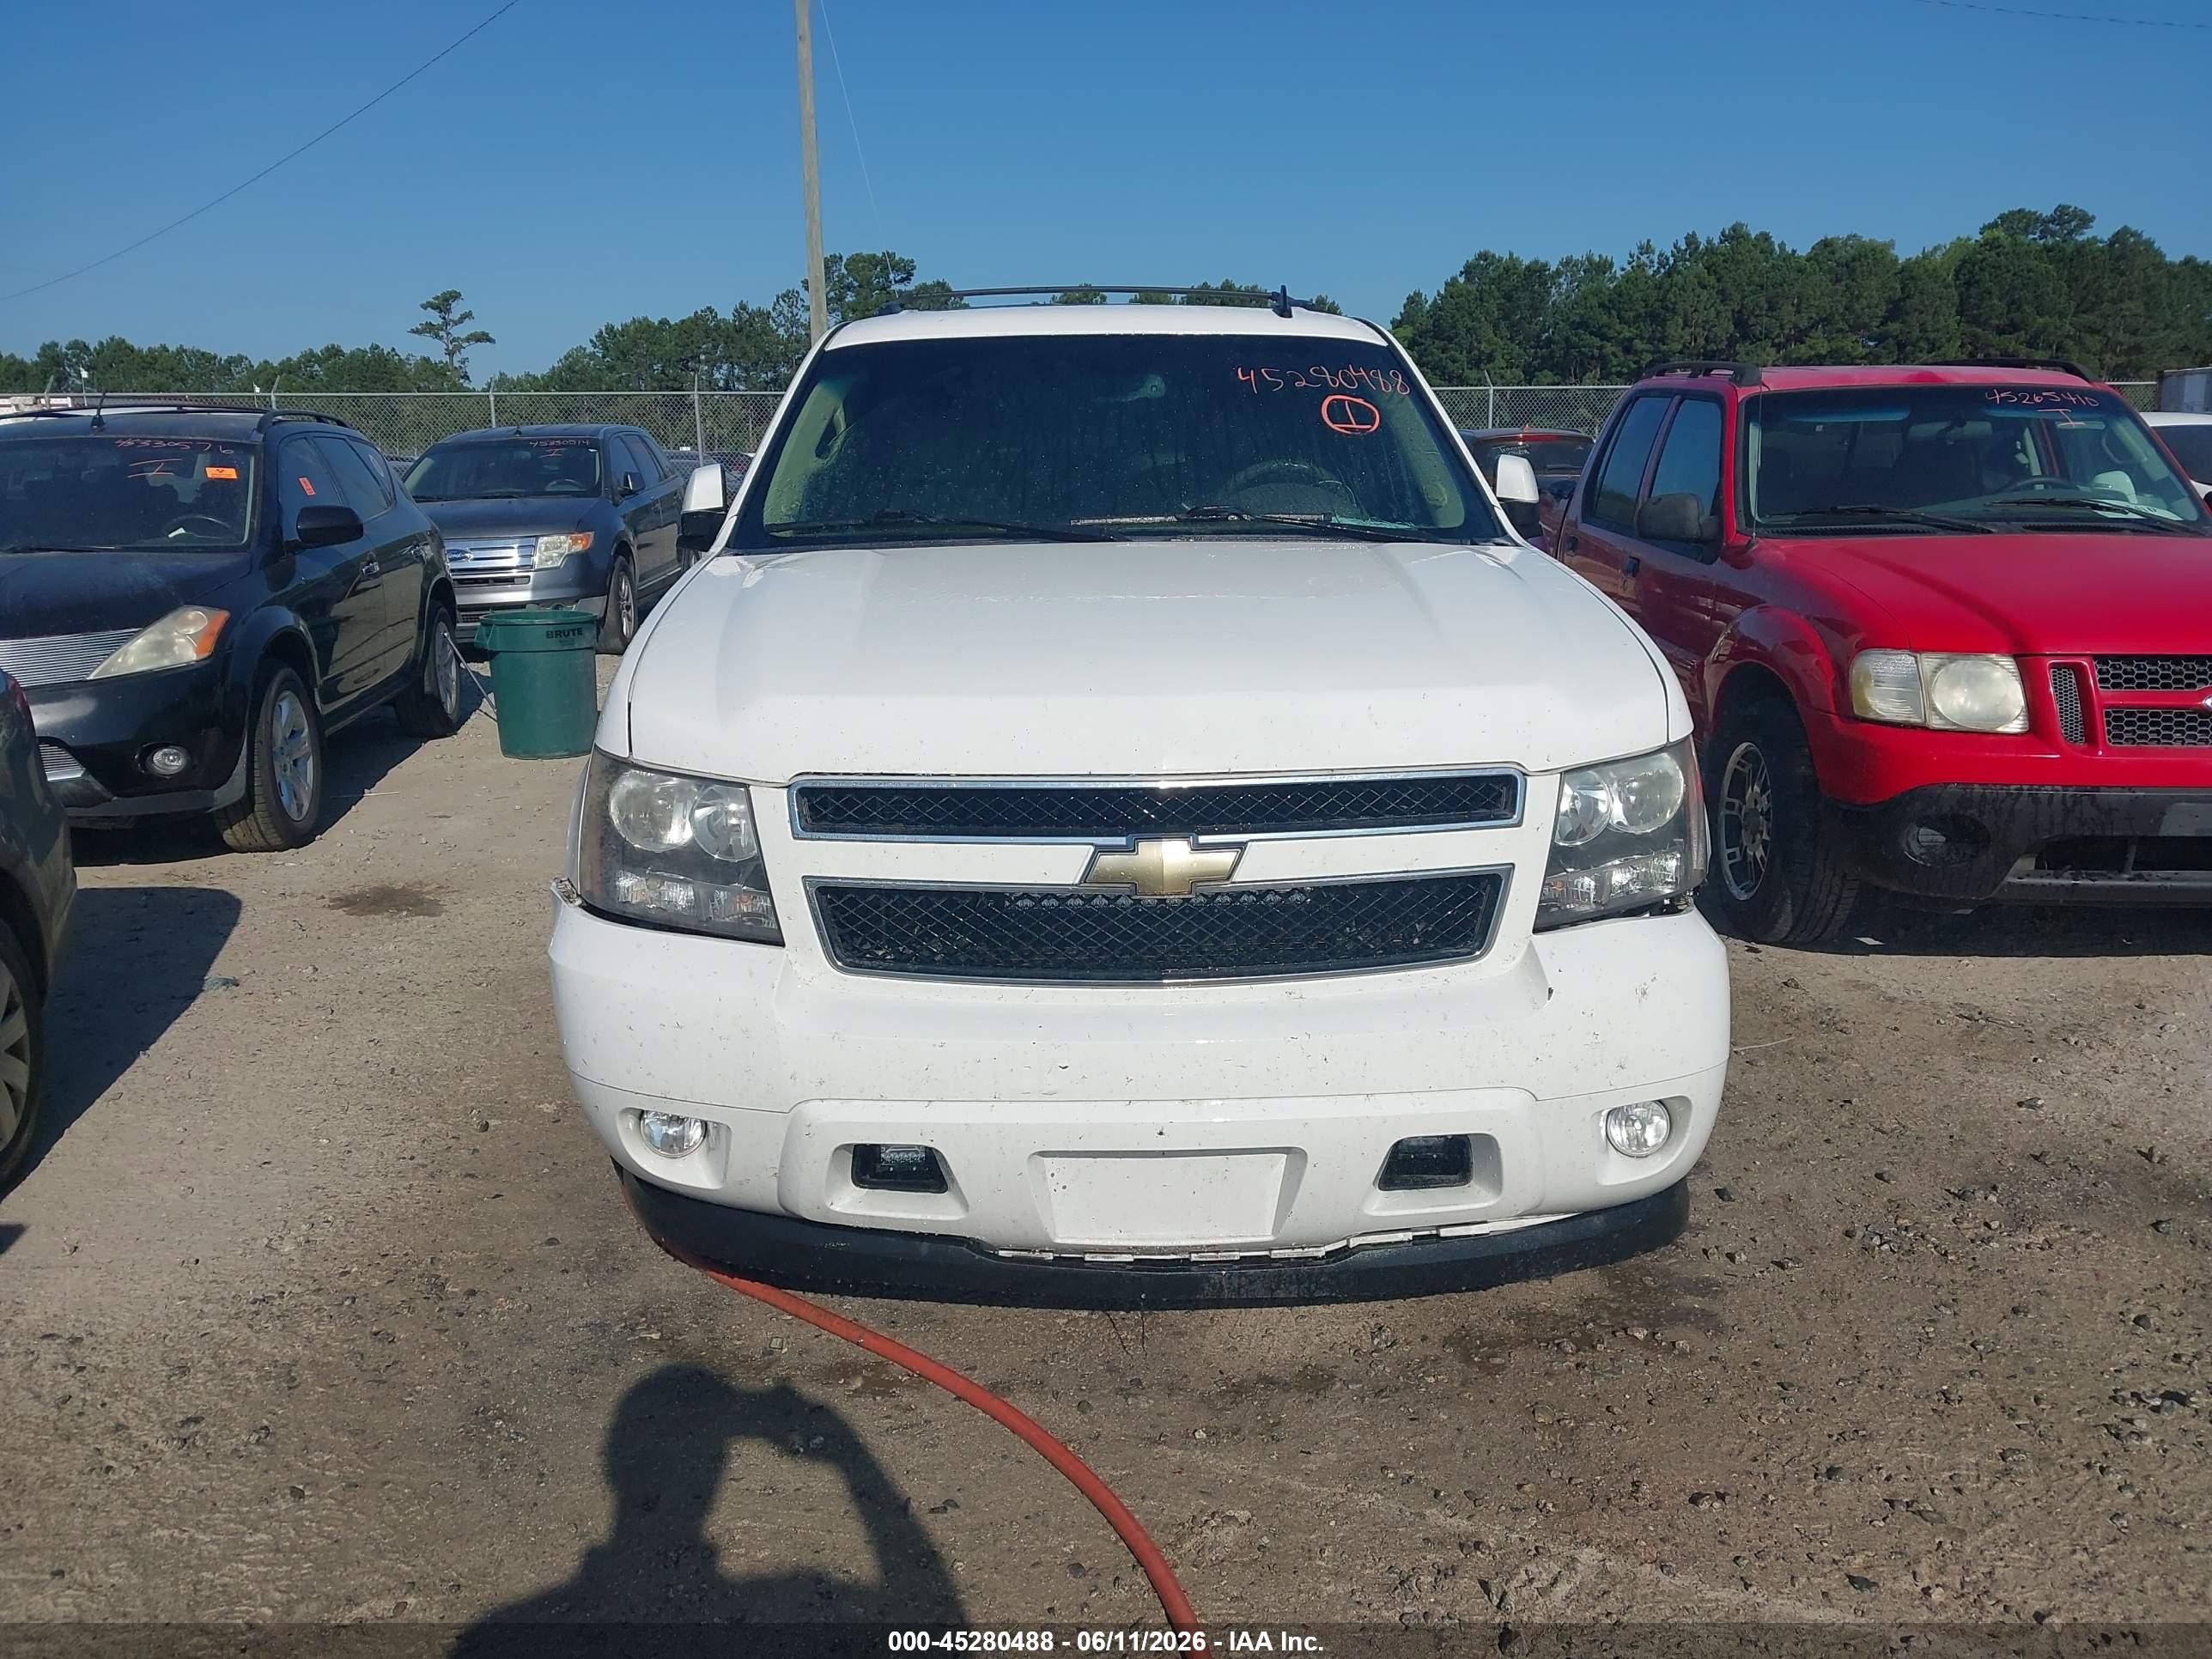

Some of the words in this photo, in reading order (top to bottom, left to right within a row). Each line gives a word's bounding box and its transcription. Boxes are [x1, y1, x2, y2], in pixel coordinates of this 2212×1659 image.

[1237, 364, 1411, 395] 45280488
[1984, 389, 2100, 406] 45265410
[545, 627, 584, 640] BRUTE
